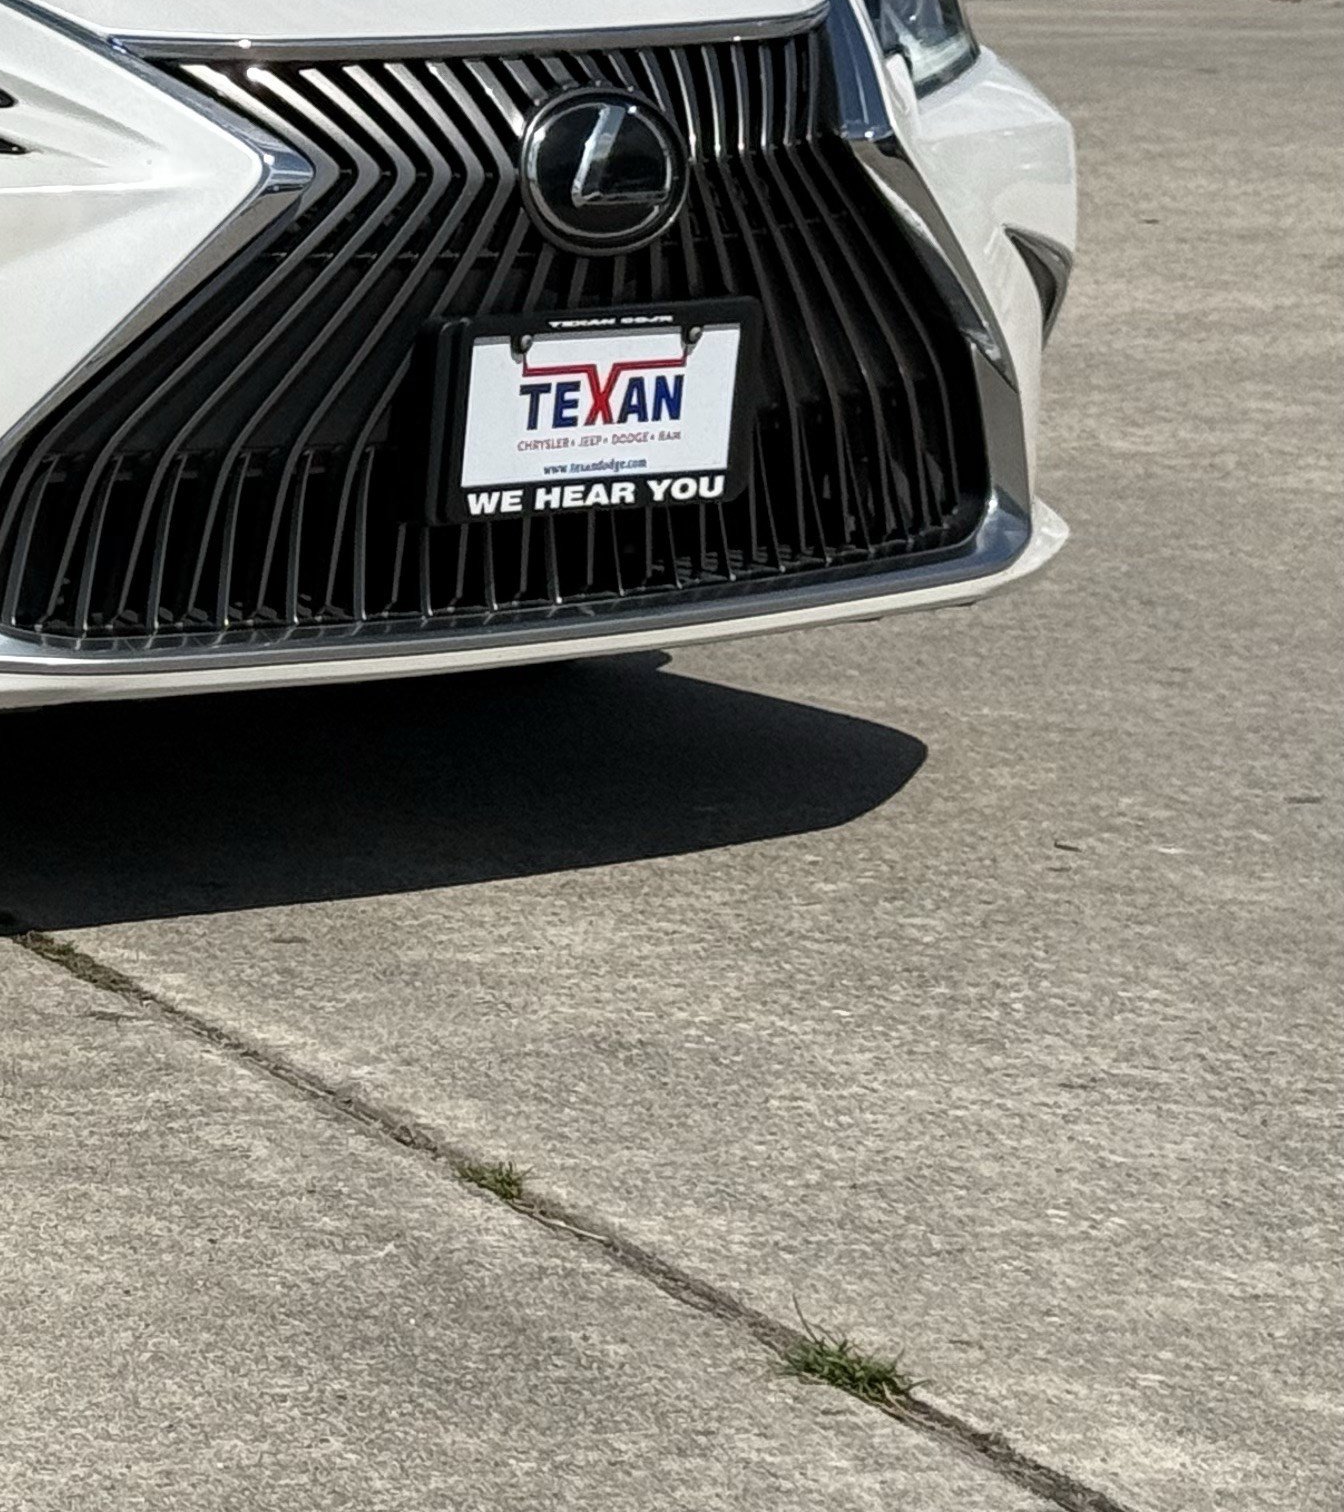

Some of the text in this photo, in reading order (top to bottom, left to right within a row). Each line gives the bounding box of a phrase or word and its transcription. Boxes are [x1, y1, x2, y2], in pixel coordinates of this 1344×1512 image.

[519, 362, 685, 431] TEXAN
[517, 436, 570, 452] CHRYSLER
[577, 434, 603, 448] JEEP
[611, 431, 649, 445] DODGE
[467, 474, 726, 516] WE HEAR YOU
